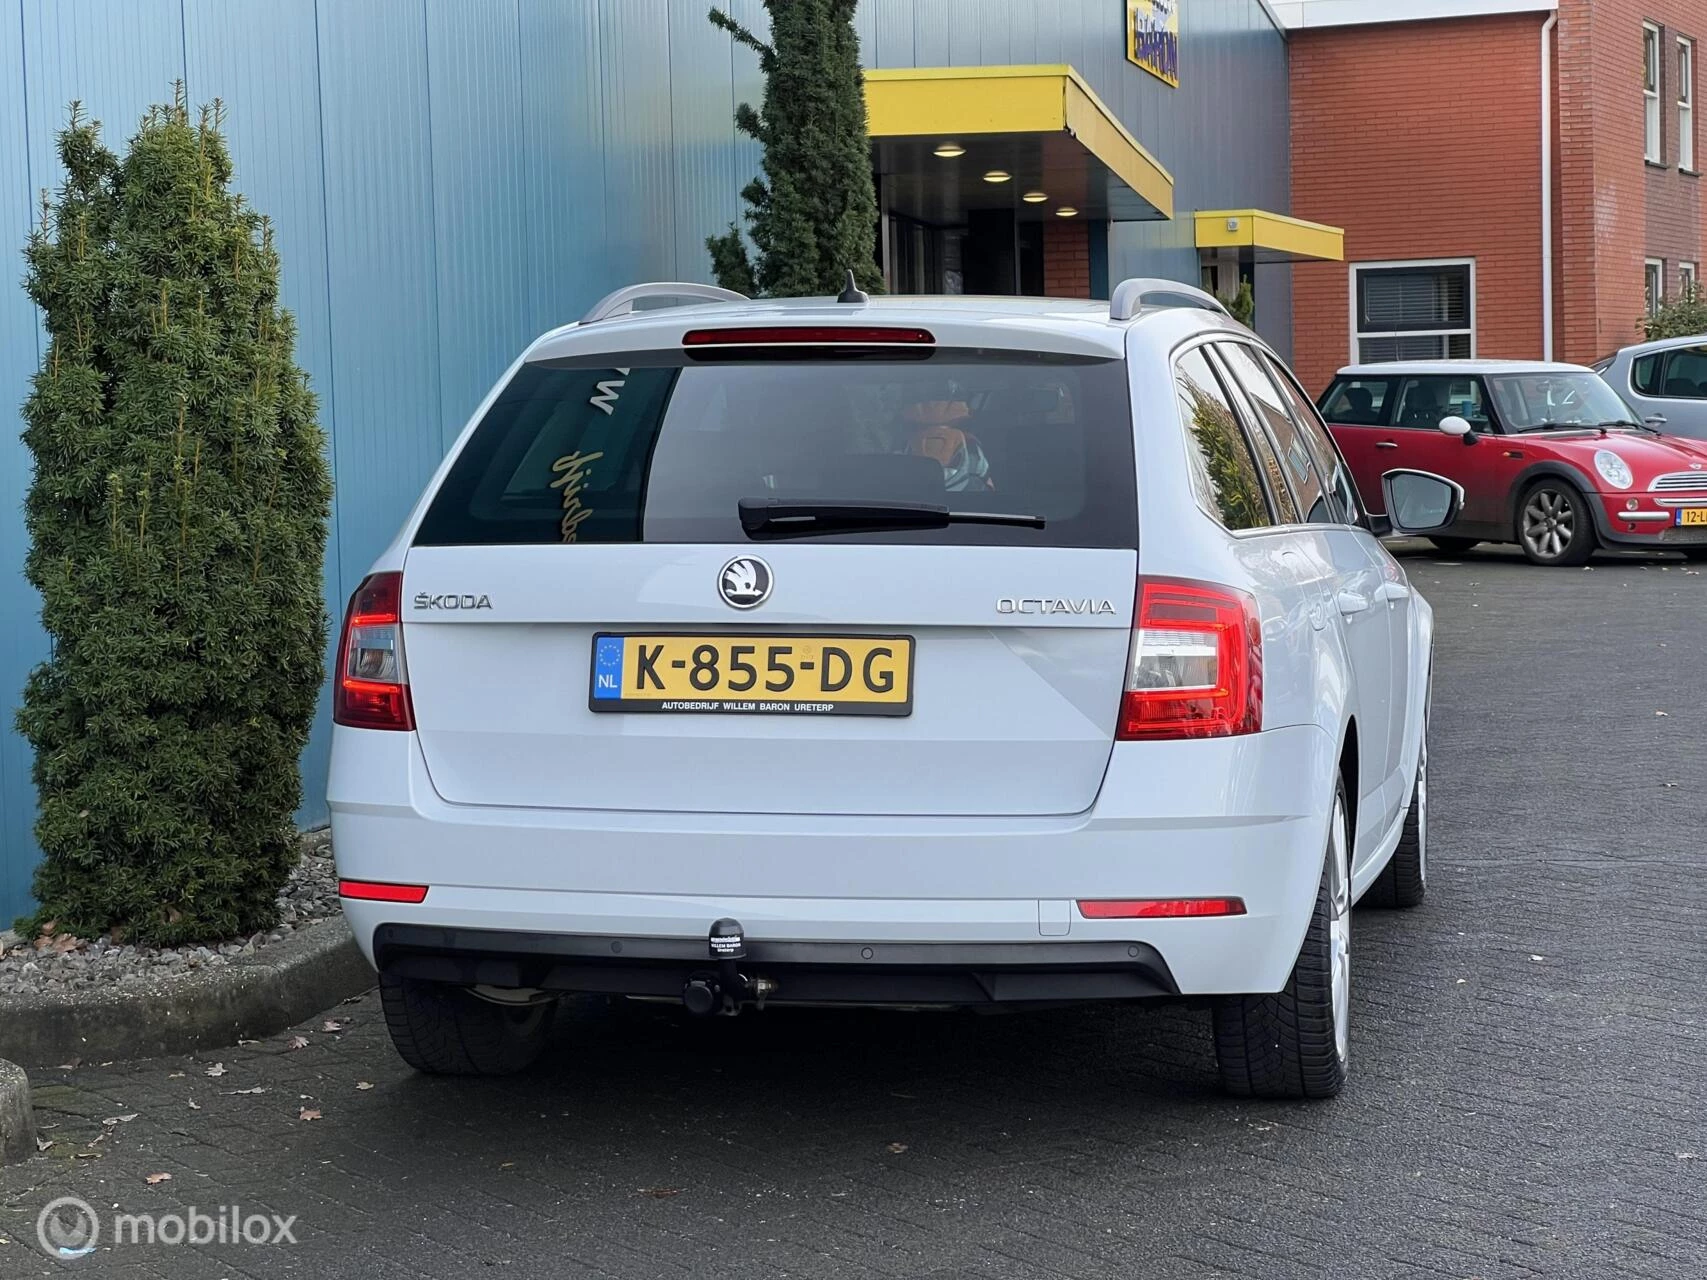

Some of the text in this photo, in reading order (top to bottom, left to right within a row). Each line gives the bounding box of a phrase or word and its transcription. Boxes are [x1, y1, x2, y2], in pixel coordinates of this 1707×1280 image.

[414, 592, 493, 610] ŠKODA
[996, 598, 1117, 615] OCTAVIA
[636, 644, 894, 694] K-855-DG
[598, 674, 617, 688] NL
[661, 702, 834, 712] AUTOBEDRIJF WILLEM BARON URETERP
